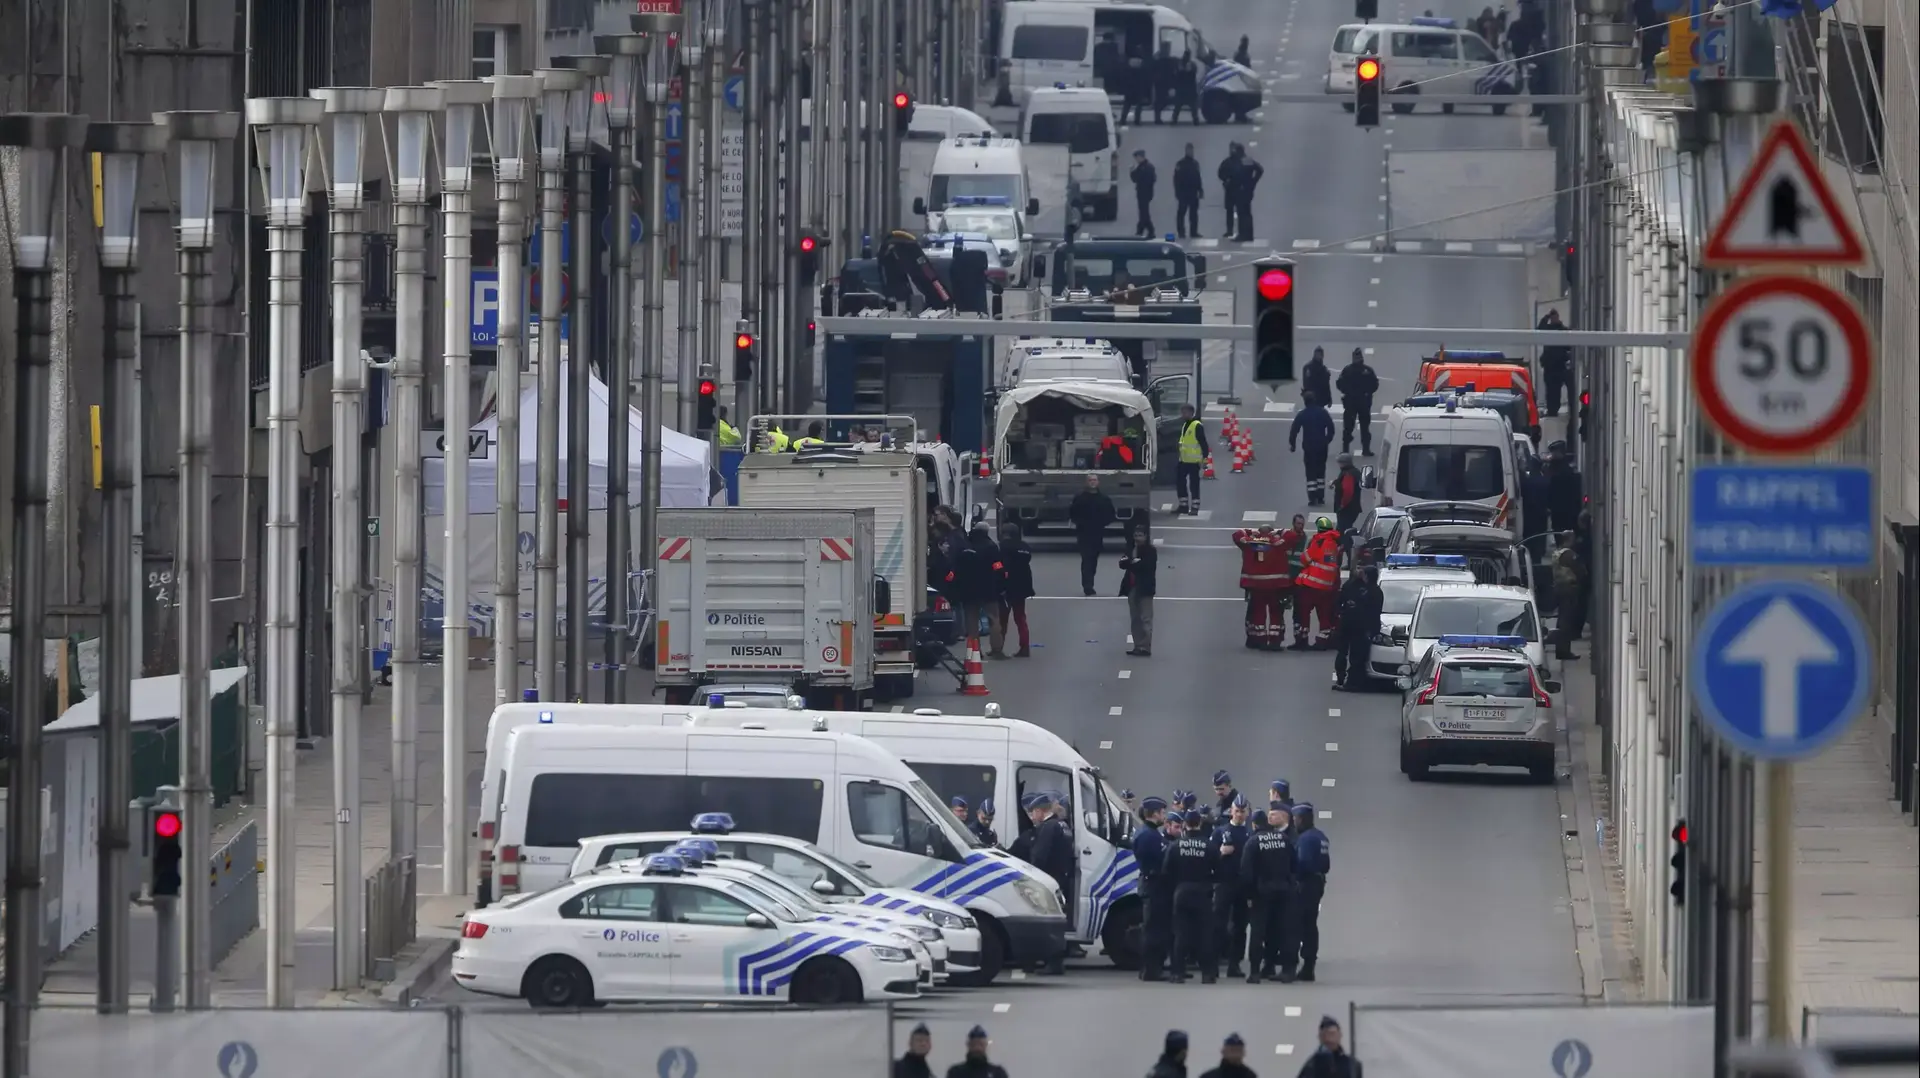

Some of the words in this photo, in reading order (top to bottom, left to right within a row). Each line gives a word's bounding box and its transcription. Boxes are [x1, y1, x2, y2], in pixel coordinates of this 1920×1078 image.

[652, 2, 671, 12] LET
[473, 332, 489, 341] LOI
[1738, 317, 1830, 380] 50
[723, 613, 765, 625] Politie
[731, 646, 782, 656] NISSAN
[1448, 721, 1471, 729] Politie
[1258, 832, 1283, 841] Police
[1179, 839, 1207, 848] Politie
[1259, 840, 1286, 850] Politie
[1180, 848, 1206, 856] Police
[620, 930, 660, 942] Police
